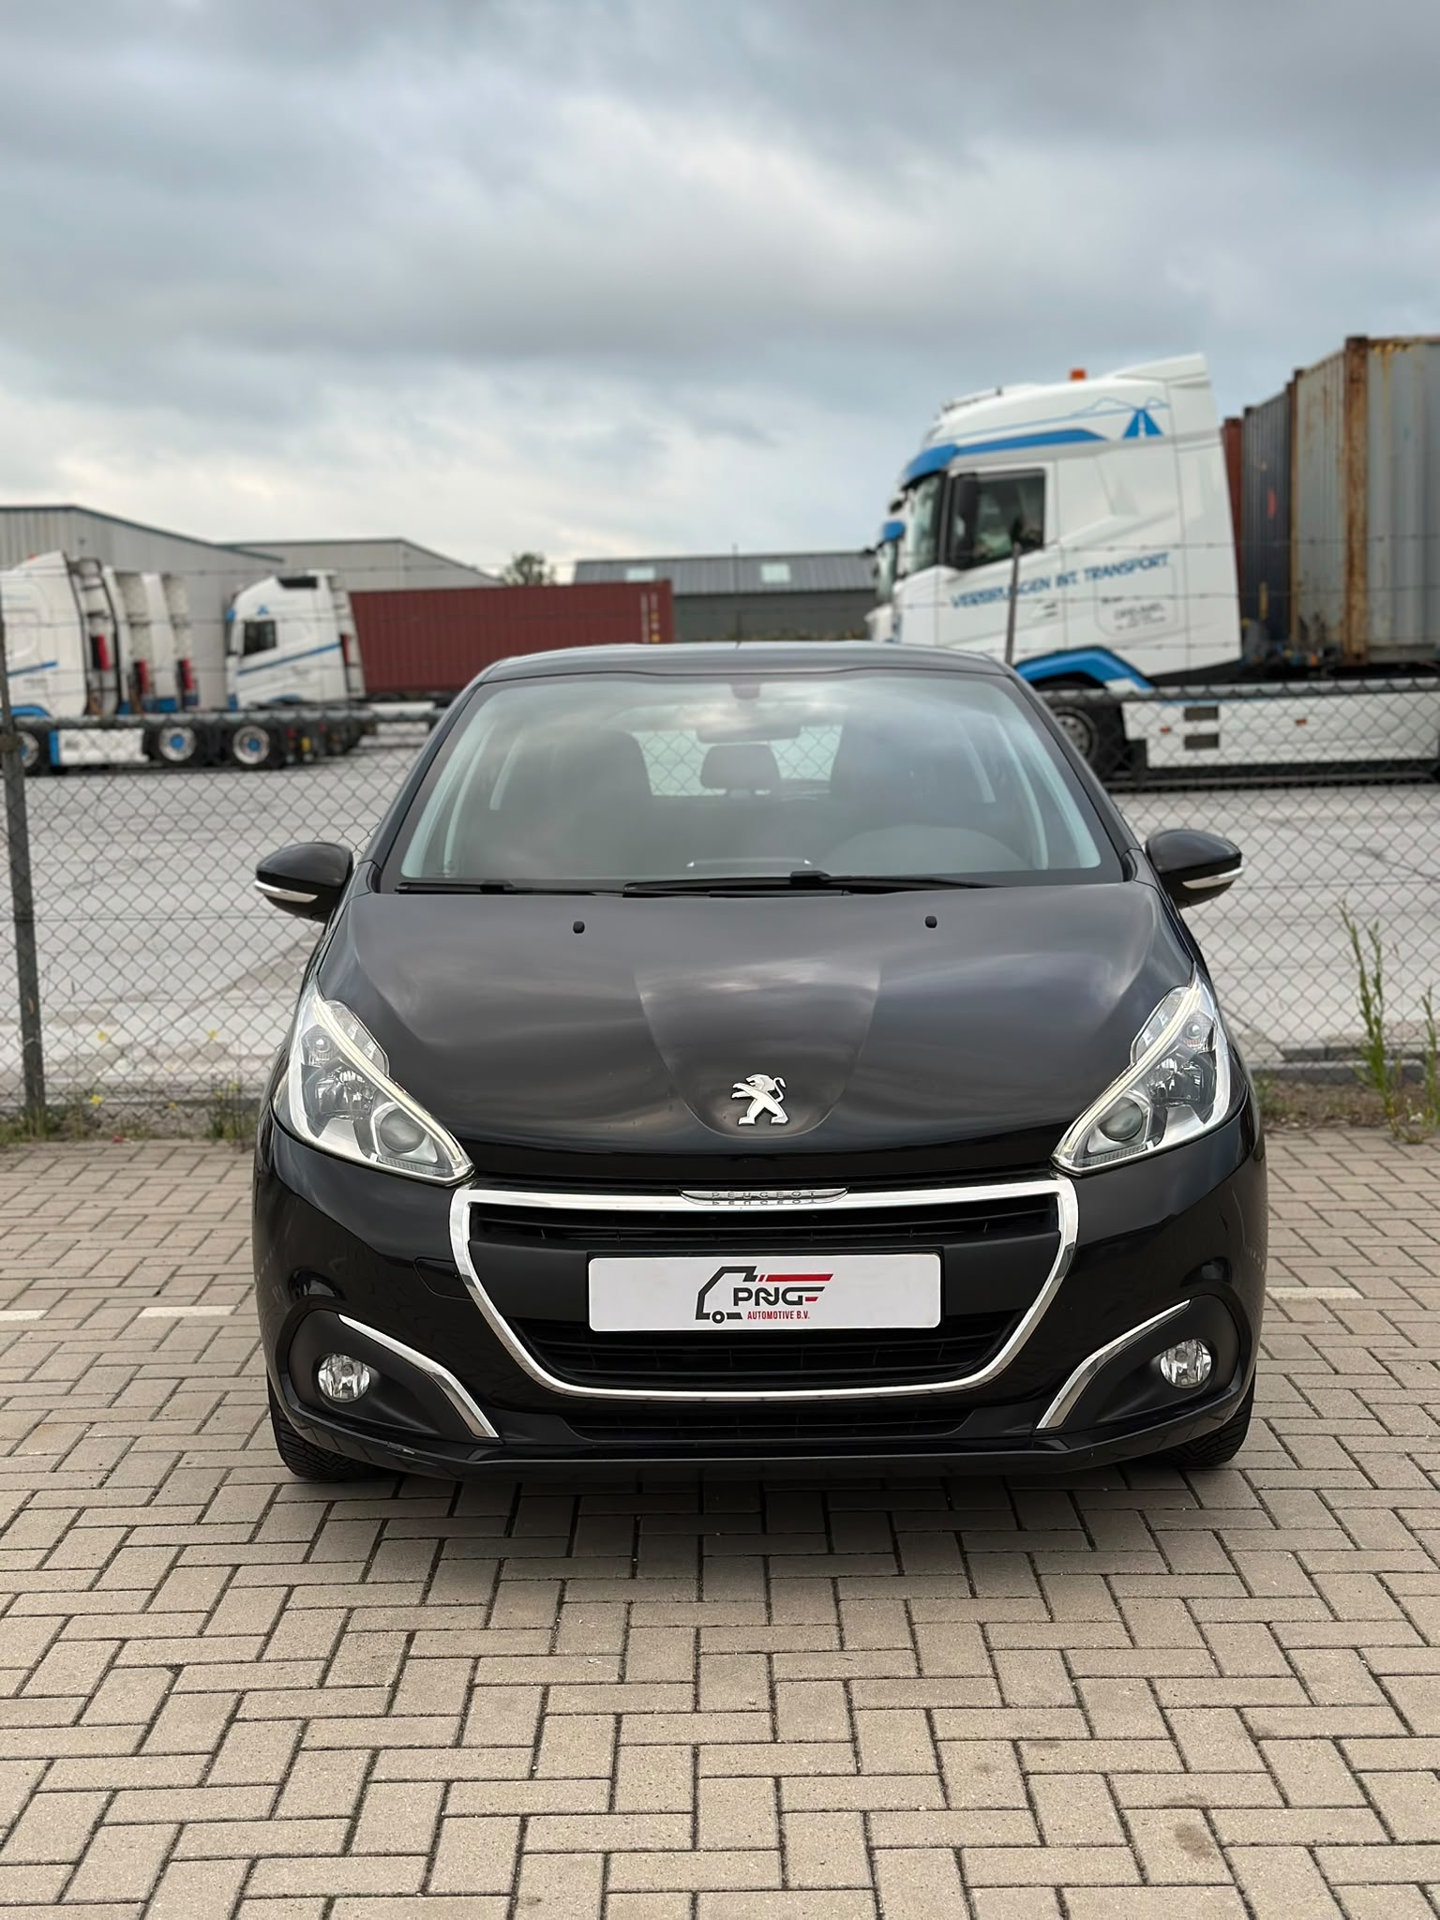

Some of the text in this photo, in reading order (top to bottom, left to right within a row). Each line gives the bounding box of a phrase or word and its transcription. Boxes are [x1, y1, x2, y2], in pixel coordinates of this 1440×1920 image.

[1084, 552, 1169, 581] TRANSPORT
[712, 1190, 816, 1199] PEUGEOT
[733, 1286, 825, 1306] PNG
[747, 1310, 810, 1320] AUTOMOTIVE B.V.
